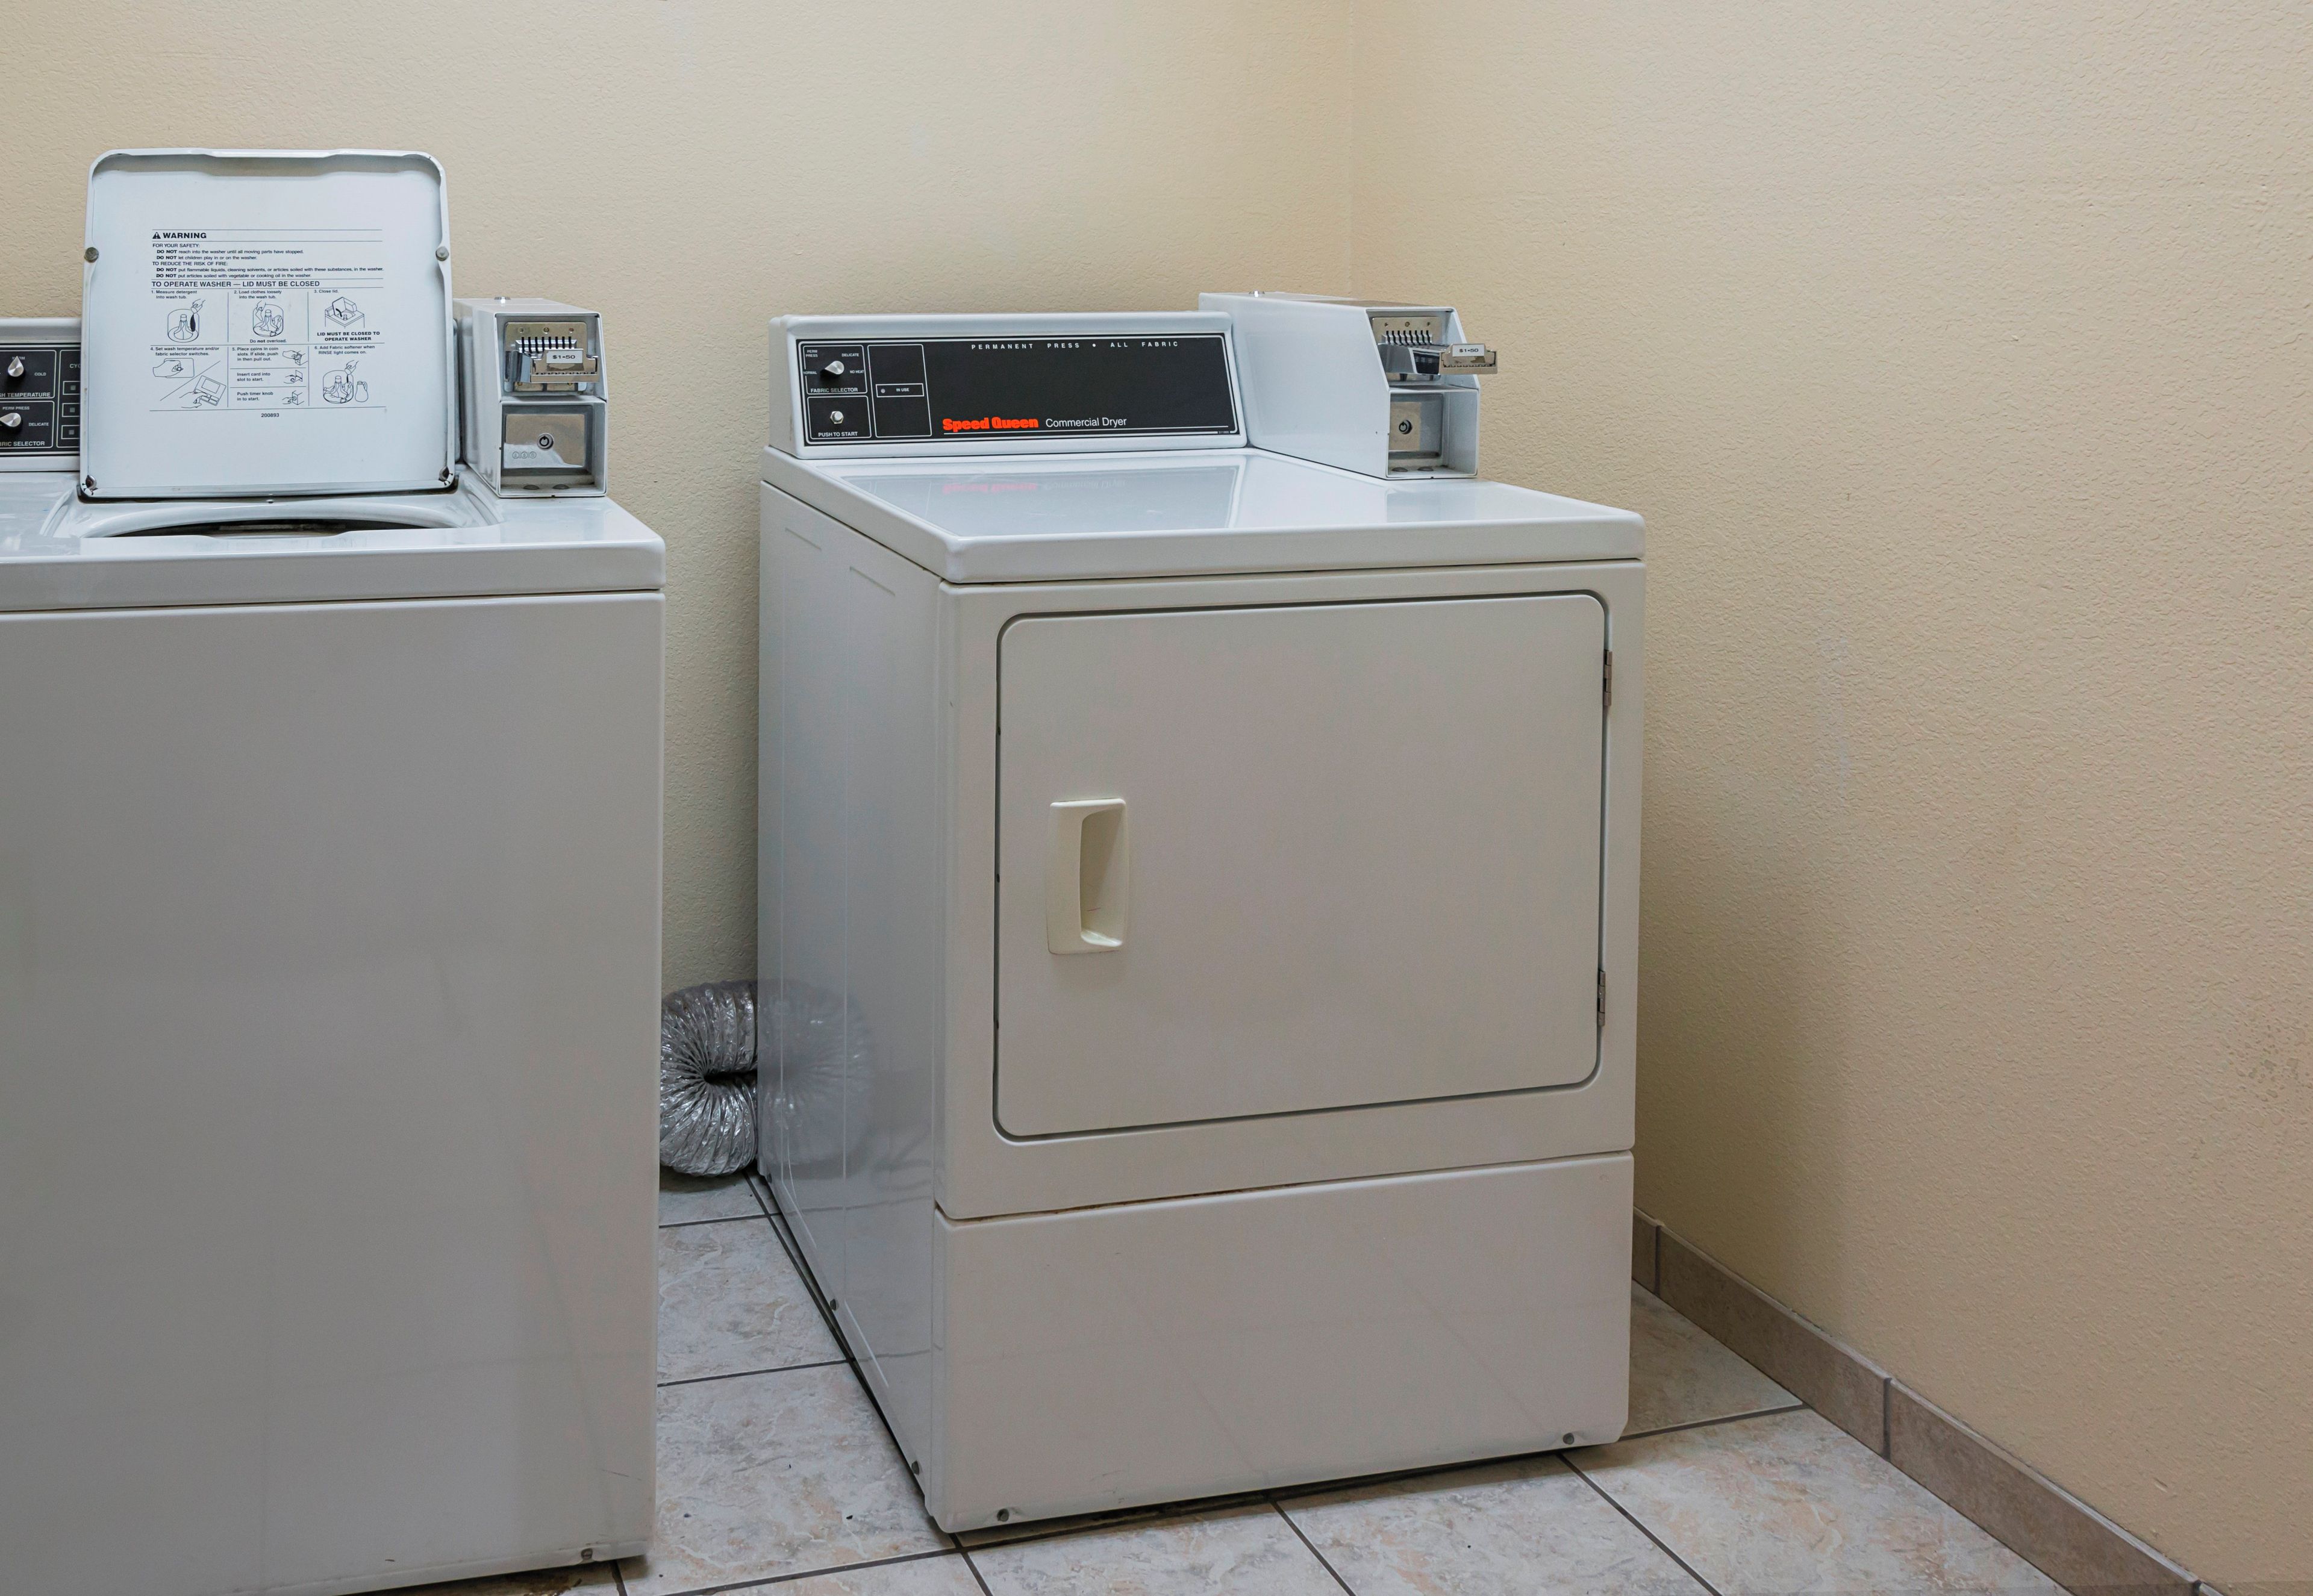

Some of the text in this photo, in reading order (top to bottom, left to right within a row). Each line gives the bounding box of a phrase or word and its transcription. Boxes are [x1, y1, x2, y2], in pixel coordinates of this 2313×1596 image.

[943, 417, 1127, 432] Speed Queen Commercial Dryer
